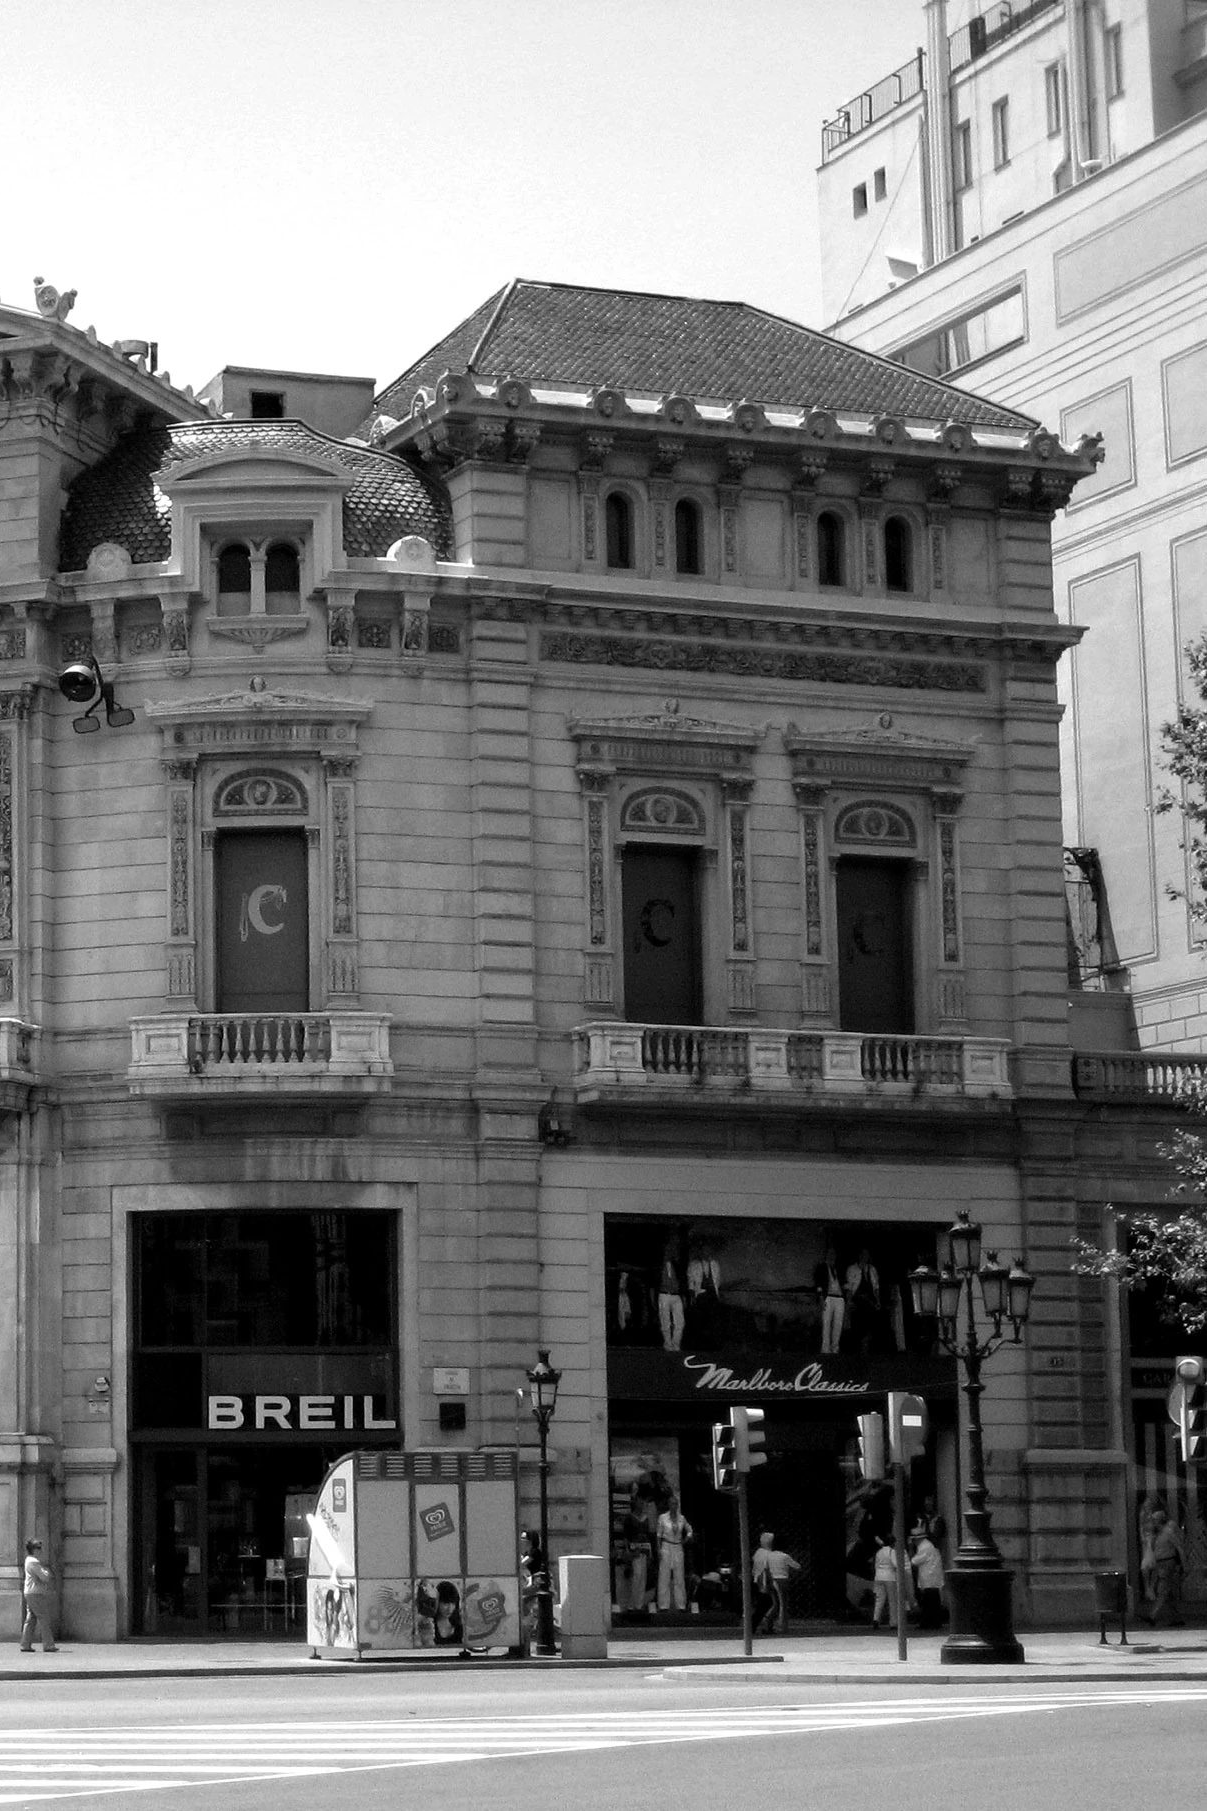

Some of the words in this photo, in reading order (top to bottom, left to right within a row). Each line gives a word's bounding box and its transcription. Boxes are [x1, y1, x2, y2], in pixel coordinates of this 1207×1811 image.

[683, 1355, 795, 1391] Marlboro
[794, 1362, 870, 1392] Classics
[208, 1395, 396, 1429] BREIL
